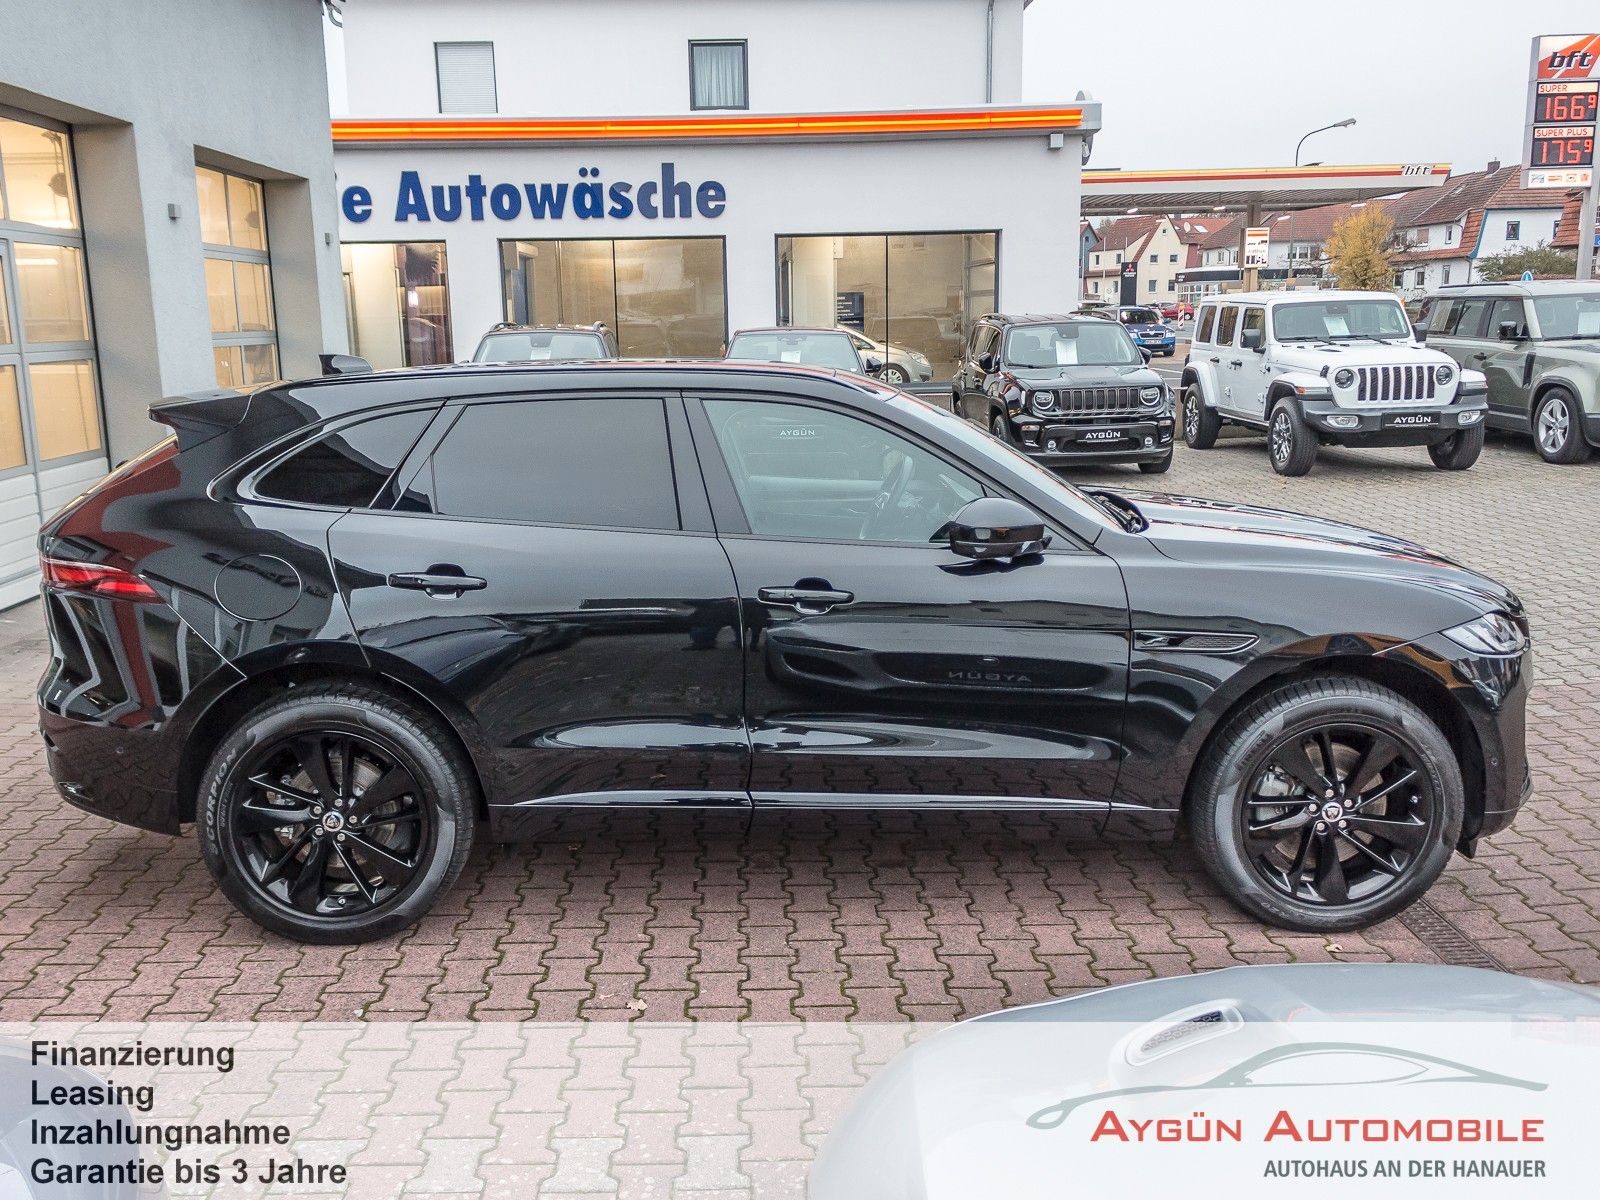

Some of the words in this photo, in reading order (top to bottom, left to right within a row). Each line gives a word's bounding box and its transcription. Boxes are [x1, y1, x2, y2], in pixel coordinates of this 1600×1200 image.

[1548, 51, 1592, 69] bft
[1540, 84, 1568, 93] SUPER
[1536, 129, 1564, 137] SUPER
[1567, 127, 1588, 136] PLUS
[1404, 165, 1430, 176] bft
[394, 162, 727, 222] Autowäsche
[1393, 414, 1432, 424] AYGÜN
[1085, 429, 1121, 440] AYGÜN
[205, 747, 237, 857] SCORPION
